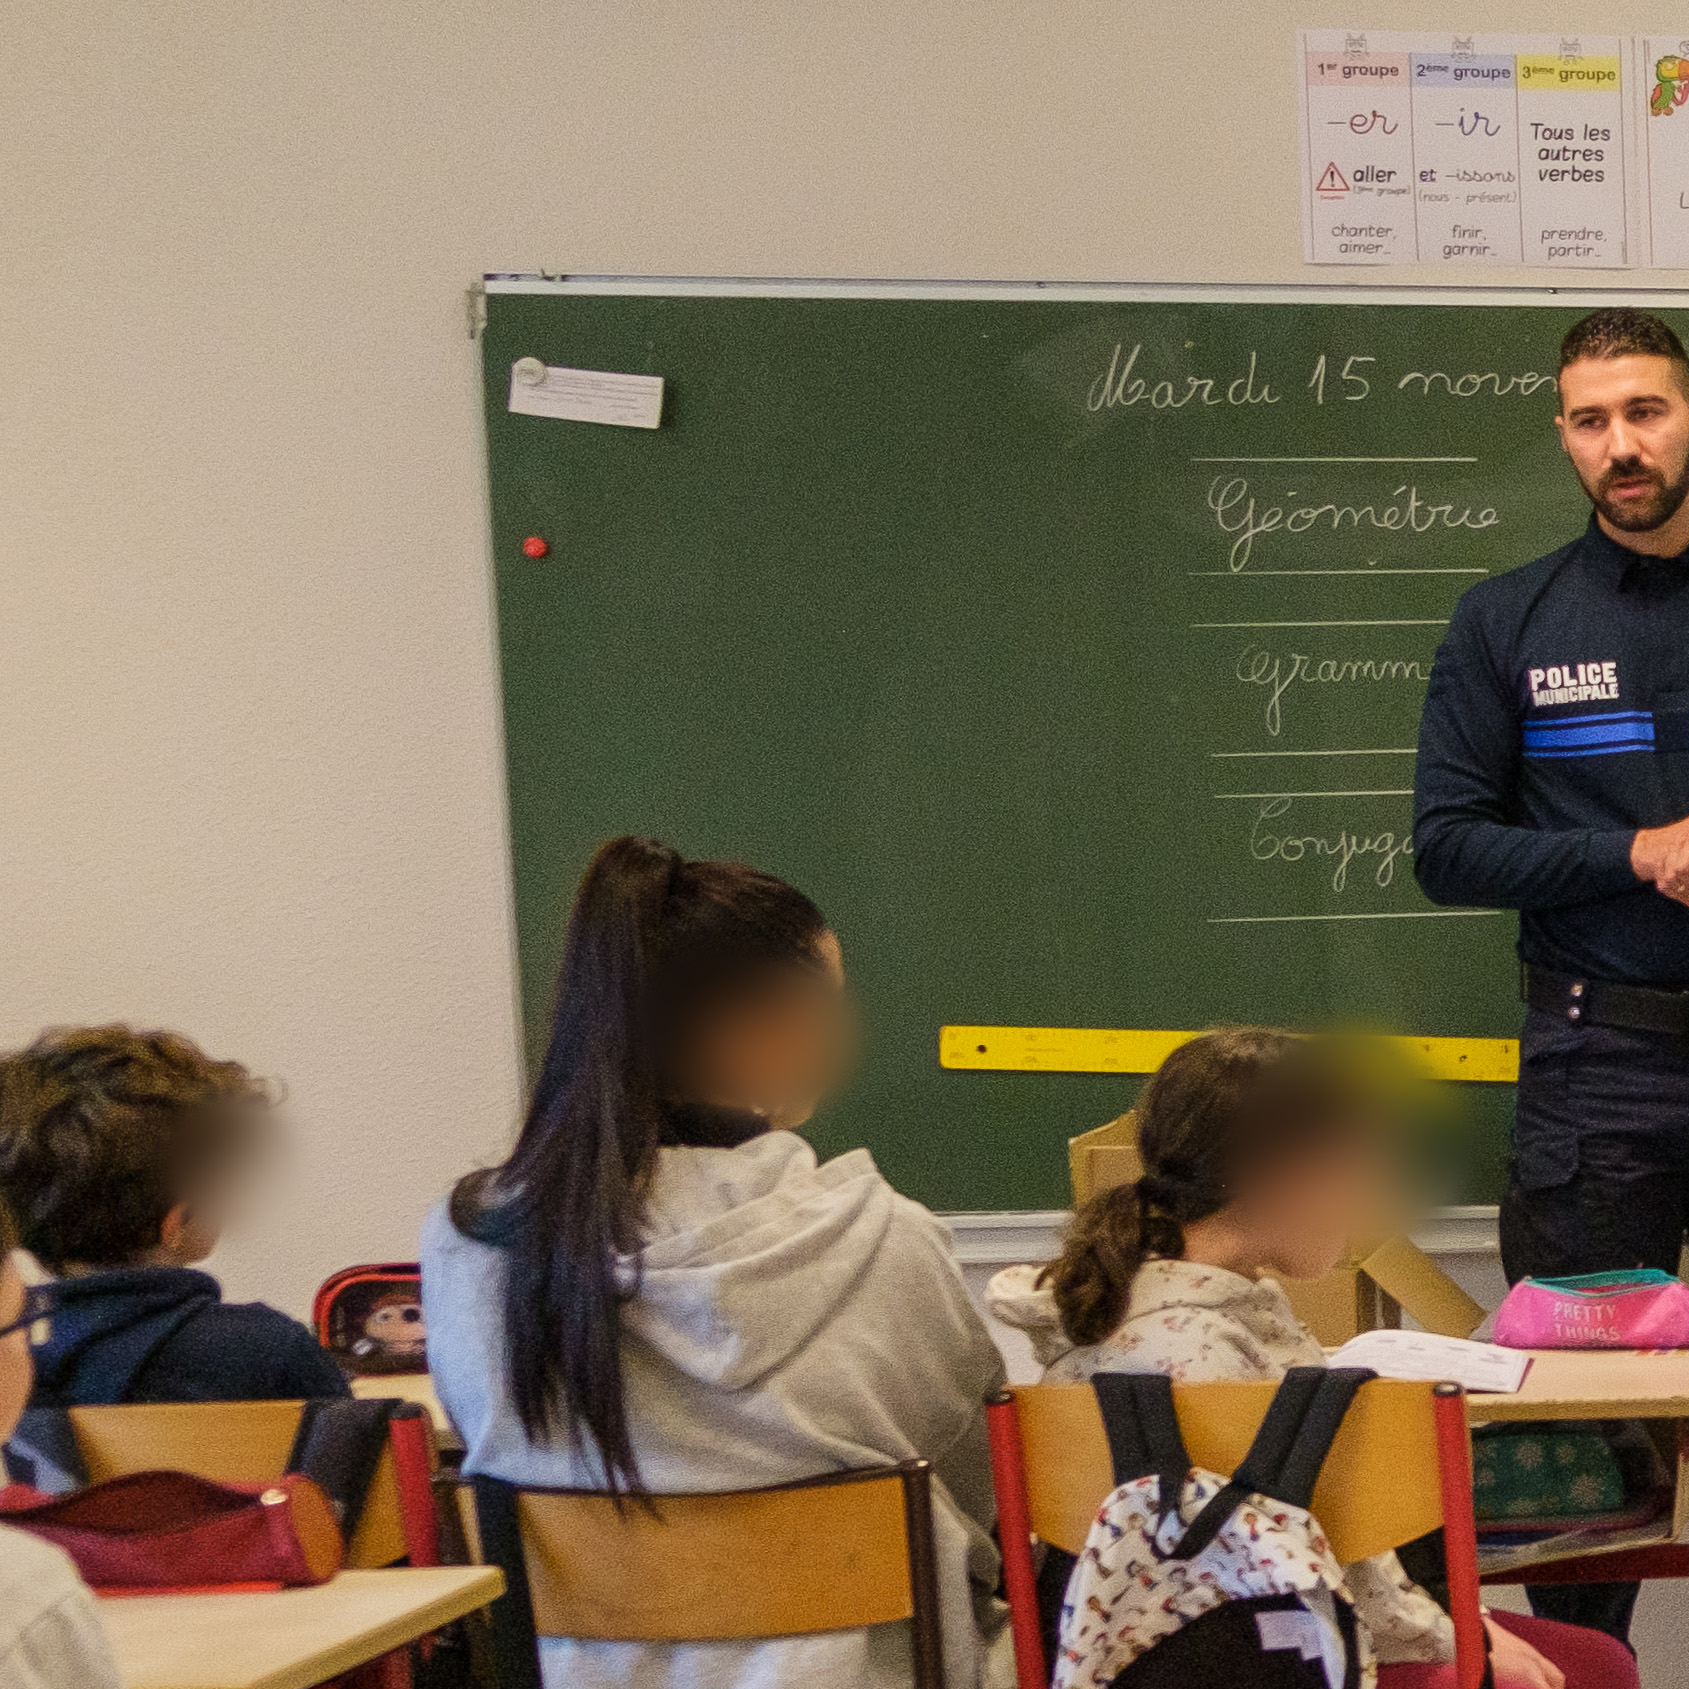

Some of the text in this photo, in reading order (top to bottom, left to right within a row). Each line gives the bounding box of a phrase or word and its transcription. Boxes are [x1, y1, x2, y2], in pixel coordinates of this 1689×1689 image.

[1342, 64, 1400, 79] groupe
[1453, 66, 1512, 81] groupe
[1558, 68, 1616, 83] groupe
[1529, 122, 1611, 142] Tous les
[1537, 147, 1605, 163] autres
[1353, 165, 1397, 183] aller
[1418, 168, 1438, 183] et
[1537, 165, 1605, 183] verbes
[1087, 343, 1282, 412] Mardi
[1308, 354, 1377, 405] 15
[1207, 473, 1501, 573] Géométrie
[1528, 661, 1618, 692] POLICE
[1235, 643, 1431, 737] Gramm
[1532, 682, 1619, 707] MUNICIPALE
[1552, 1300, 1618, 1324] PRETTY
[1553, 1323, 1622, 1342] THINGS
